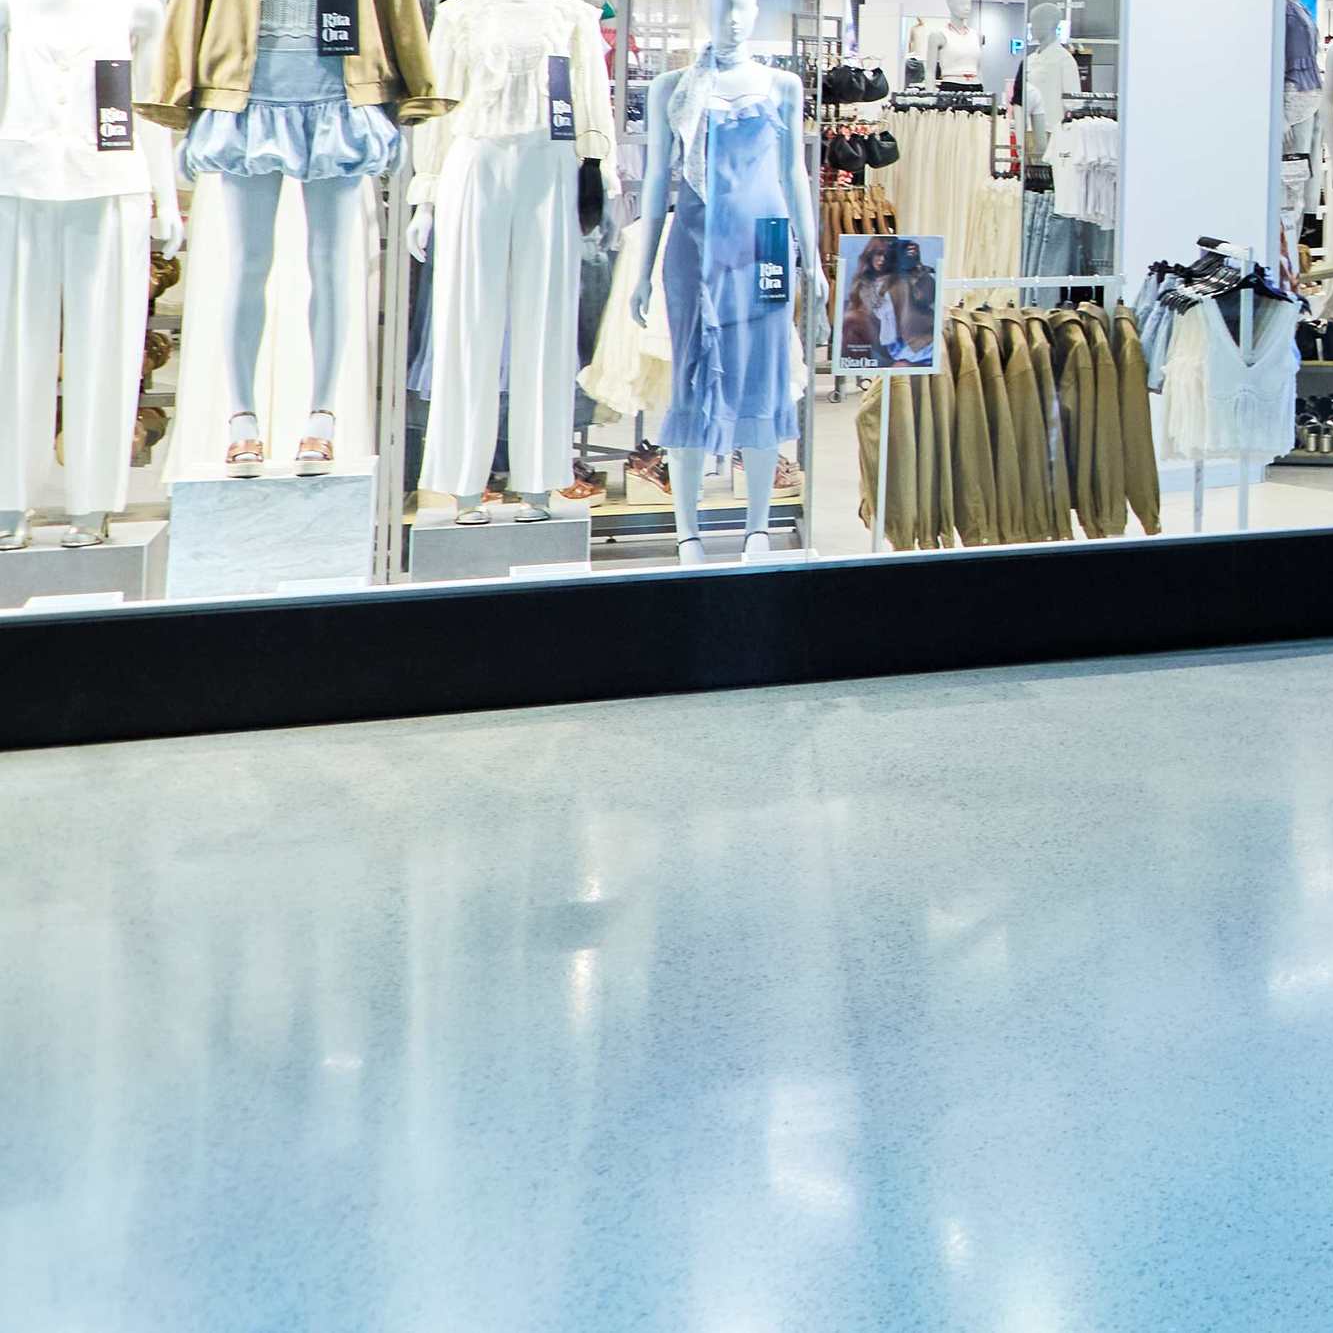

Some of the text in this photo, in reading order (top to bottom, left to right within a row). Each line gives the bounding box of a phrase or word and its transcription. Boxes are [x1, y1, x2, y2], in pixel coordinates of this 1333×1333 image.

[322, 12, 351, 28] Rita
[322, 28, 349, 43] Ora
[759, 262, 784, 276] Rita
[759, 276, 783, 291] Ora
